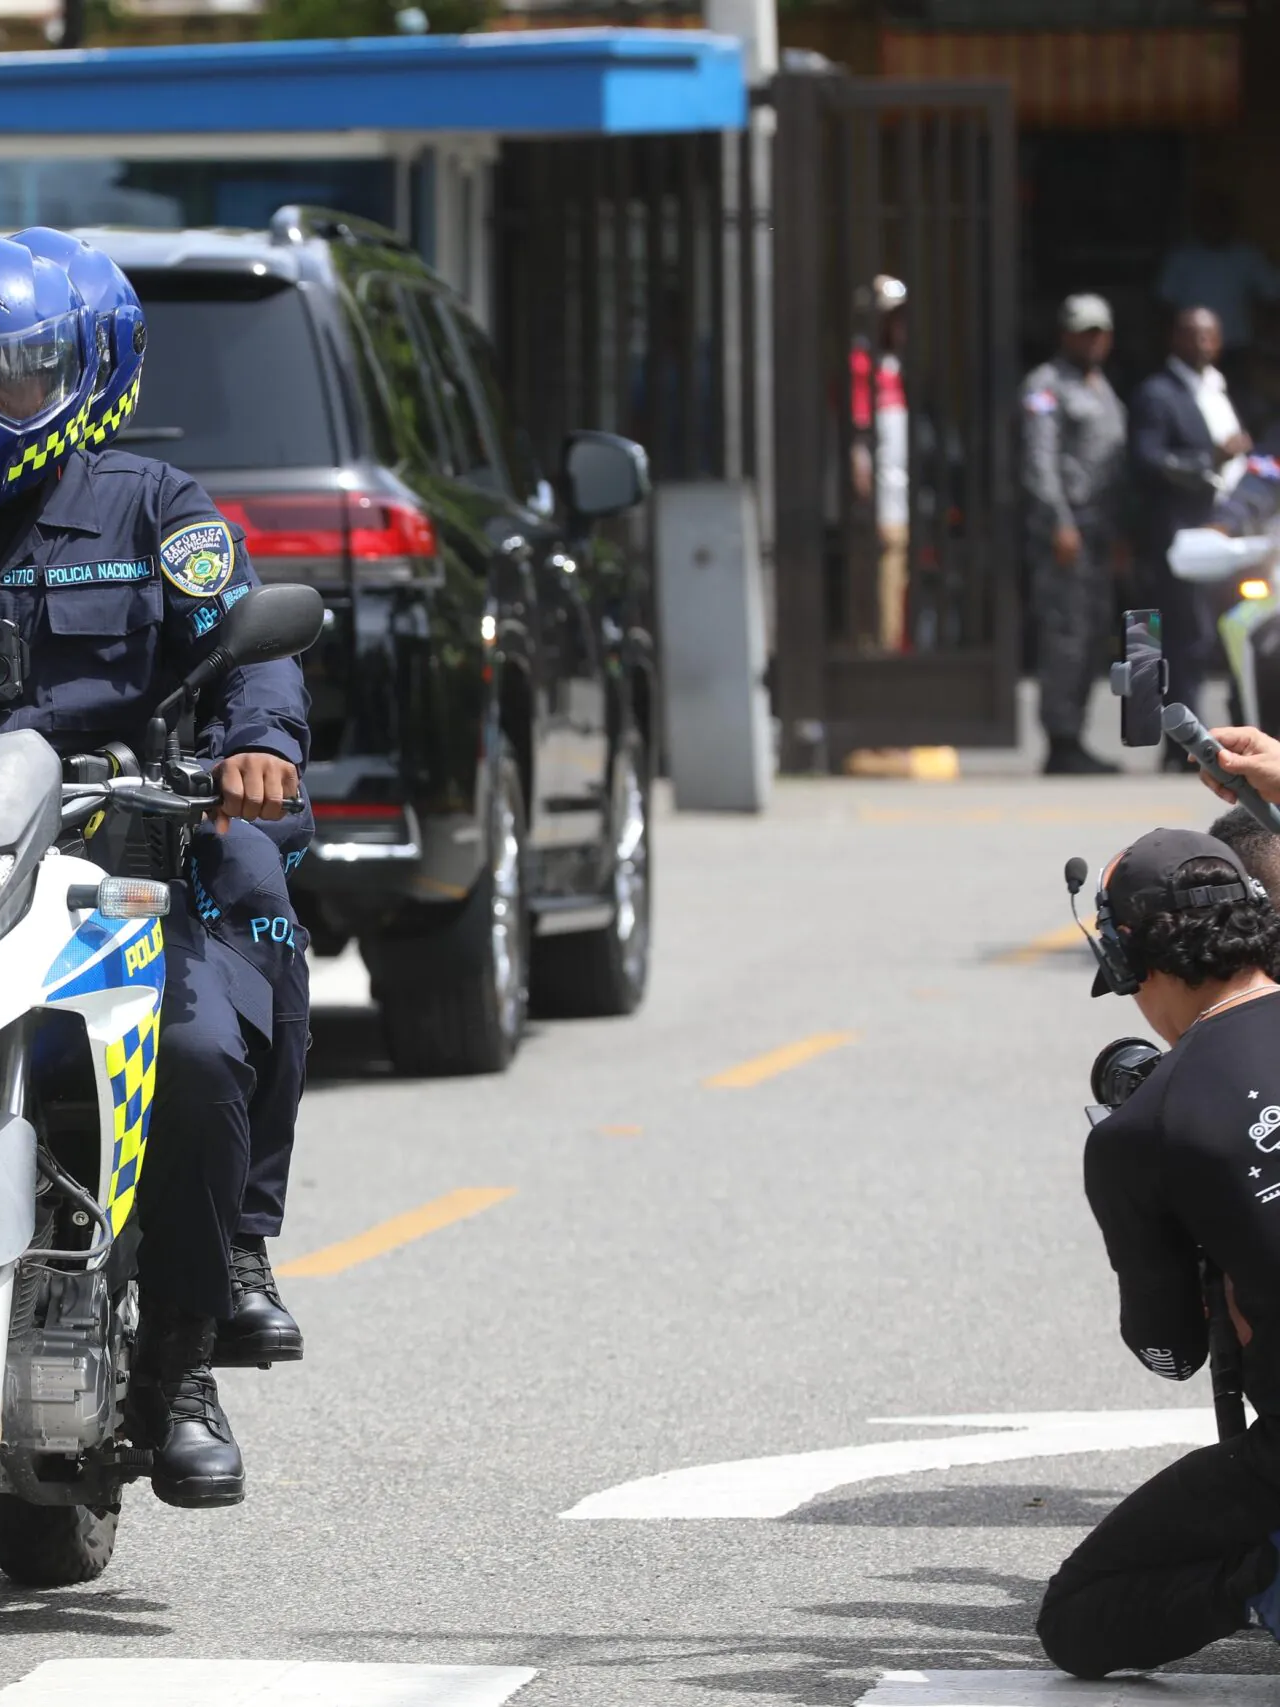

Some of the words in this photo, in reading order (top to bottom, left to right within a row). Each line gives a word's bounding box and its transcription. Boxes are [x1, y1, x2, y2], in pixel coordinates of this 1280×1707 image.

[167, 536, 221, 563] DOMINICANA
[47, 565, 94, 584] POLICIA
[97, 561, 151, 579] NACIONAL
[193, 606, 218, 634] AB+
[250, 916, 296, 950] POL
